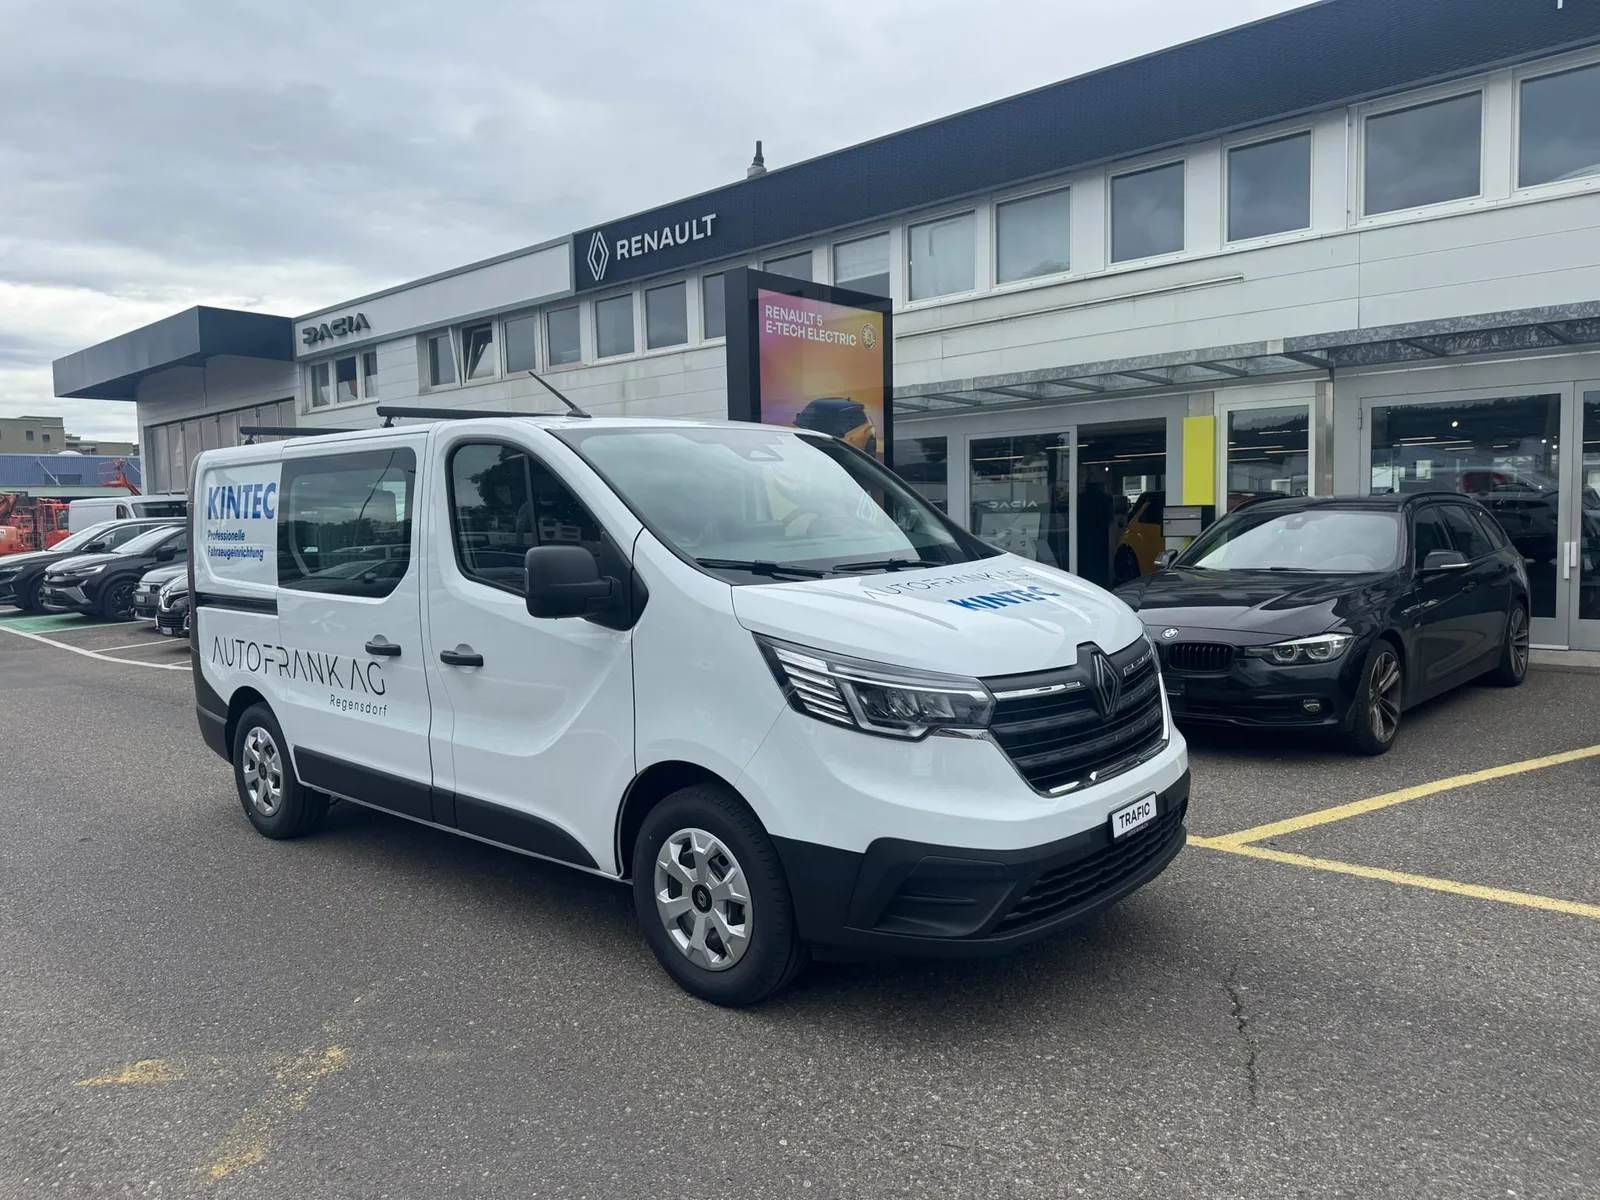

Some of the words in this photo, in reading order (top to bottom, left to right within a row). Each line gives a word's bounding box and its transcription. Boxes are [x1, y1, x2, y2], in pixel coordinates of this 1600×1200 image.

[616, 213, 717, 261] RENAULT
[302, 312, 371, 345] DACIA
[765, 305, 815, 326] RENAULT
[817, 315, 823, 327] 5
[765, 320, 806, 339] E-TECH
[807, 327, 857, 347] ELECTRIC
[207, 482, 277, 521] KINTEC
[988, 500, 1038, 508] DACIA
[207, 530, 246, 542] Professionelle
[207, 546, 264, 562] Fahrzeugeinrichtung
[947, 586, 1061, 611] KINTEC
[212, 636, 344, 688] AUTOFRANK
[350, 658, 386, 696] AG
[329, 694, 388, 716] Regensdorf
[1119, 802, 1150, 829] TRAFIC
